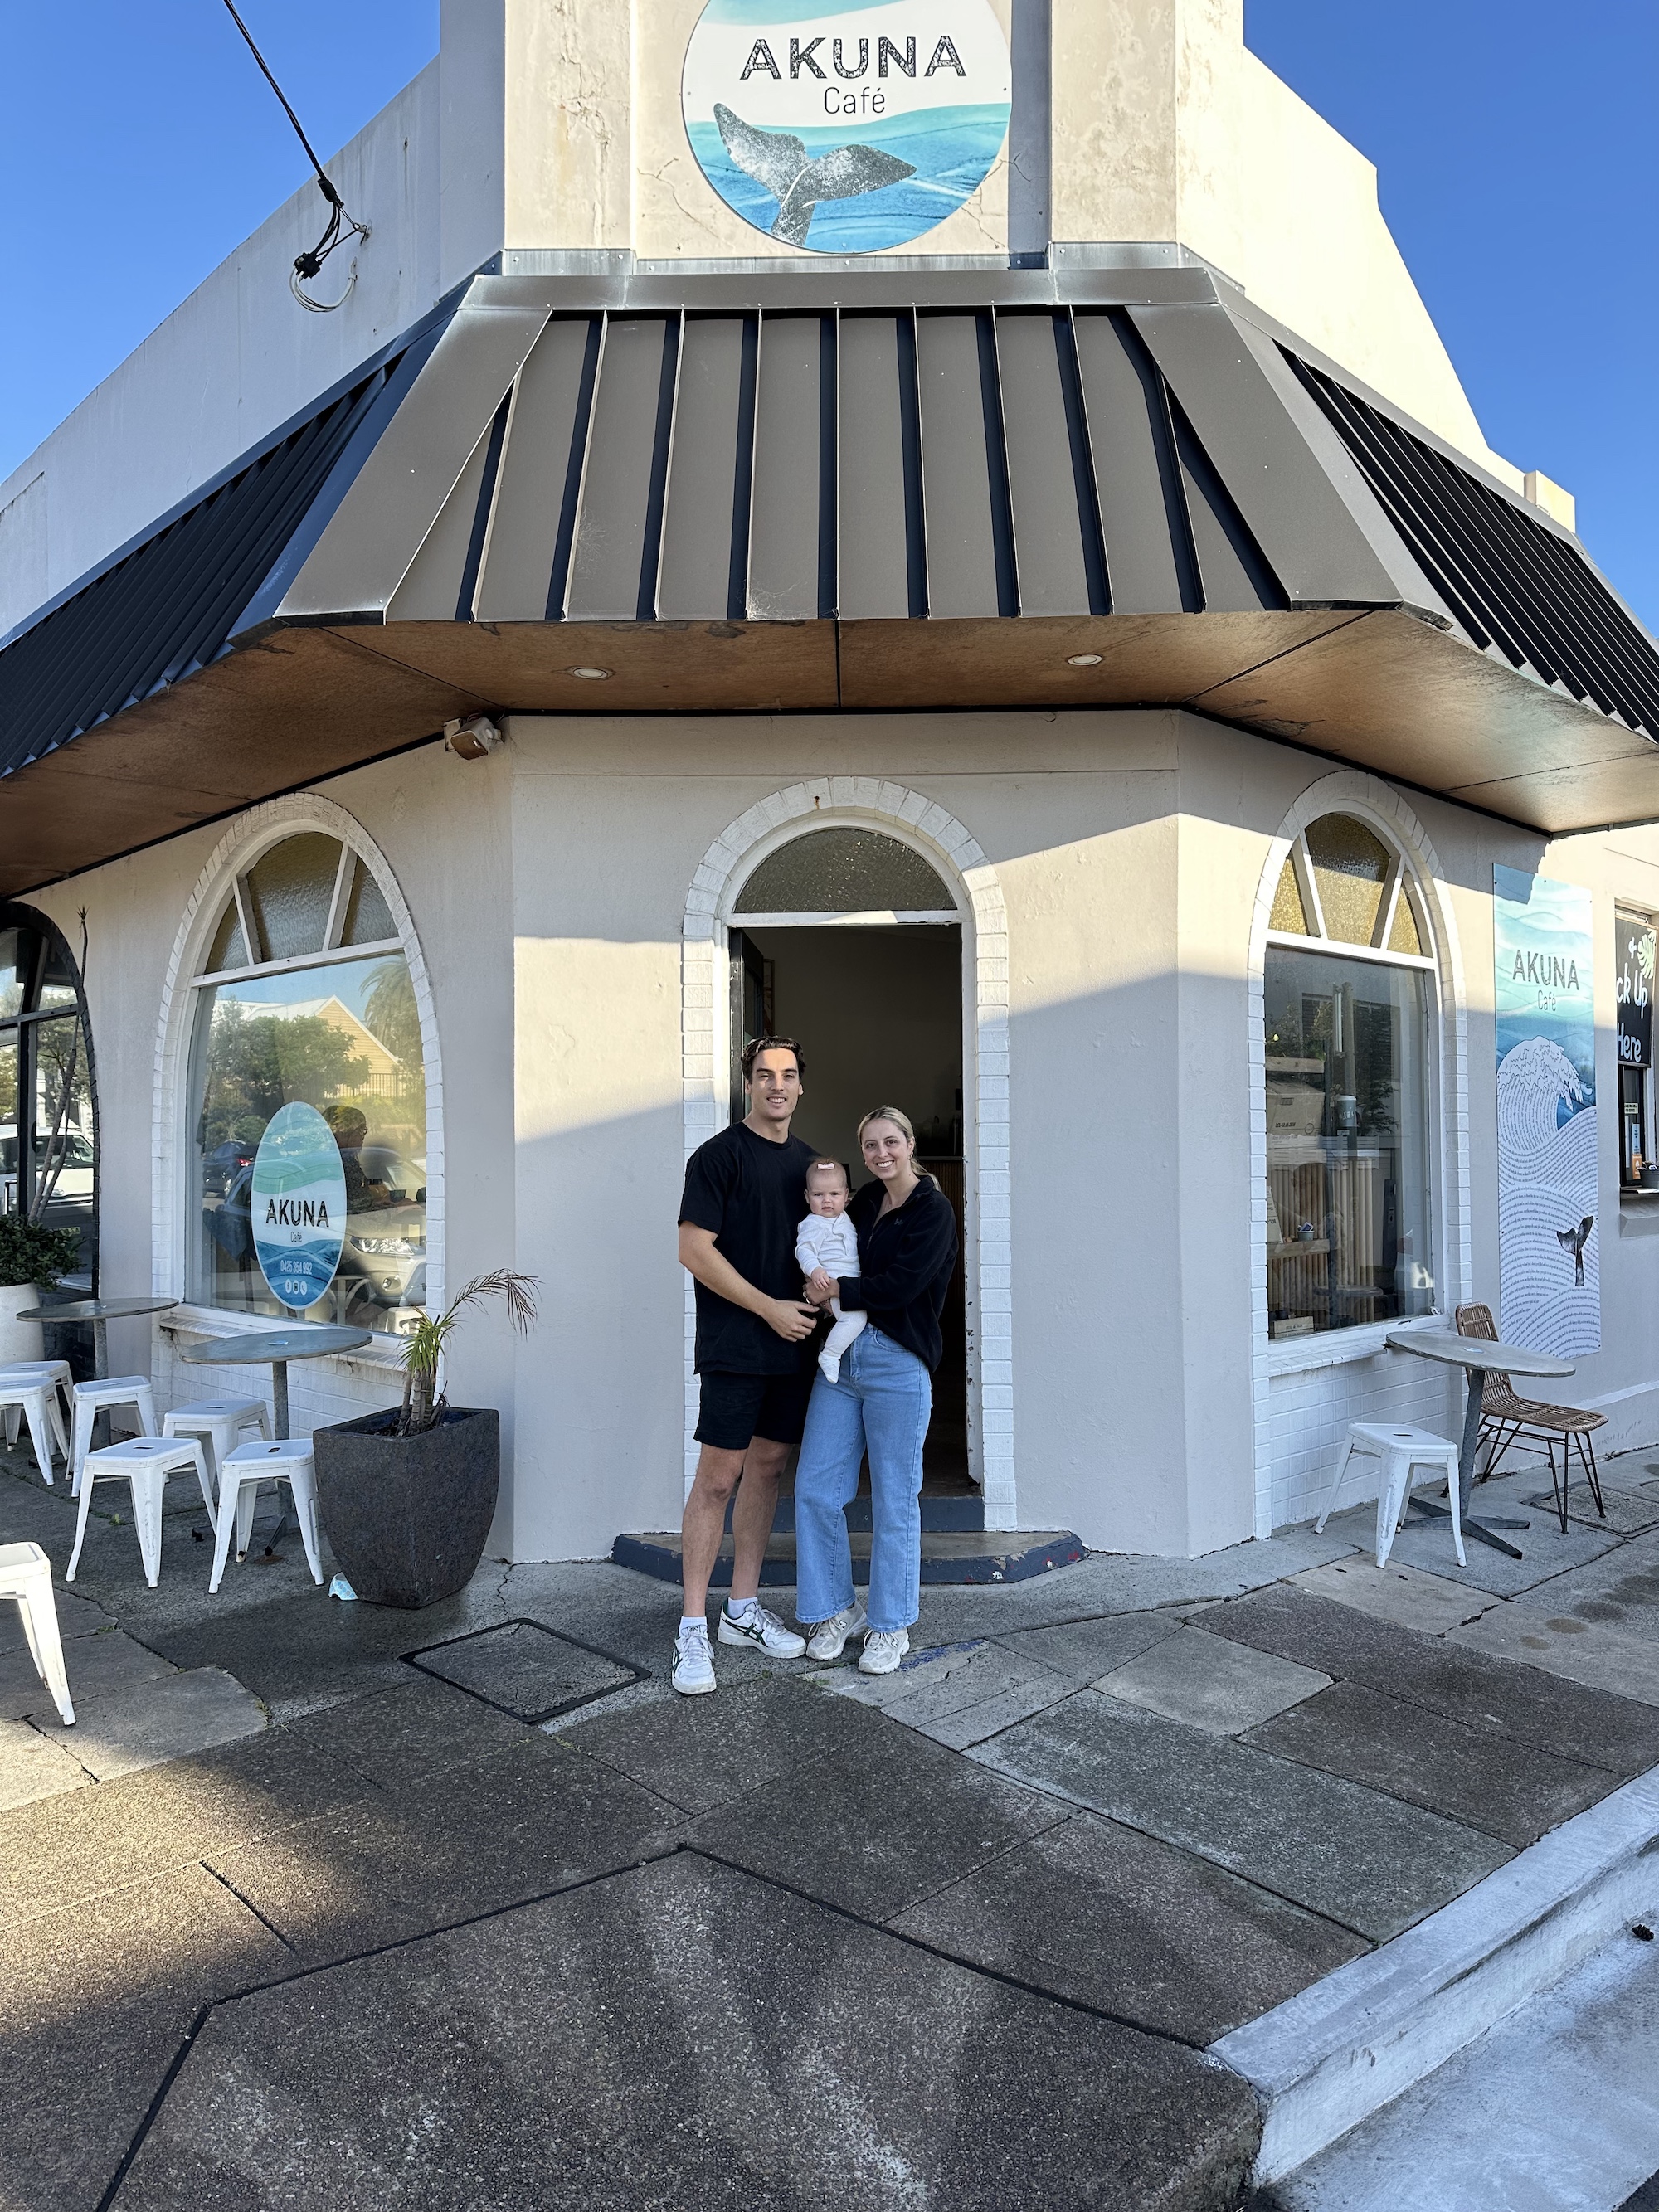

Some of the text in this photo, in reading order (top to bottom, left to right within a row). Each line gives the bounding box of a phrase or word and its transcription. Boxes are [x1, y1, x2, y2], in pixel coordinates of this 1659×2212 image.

[739, 36, 967, 80] AKUNA
[824, 86, 886, 114] Café
[1512, 949, 1580, 991] AKUNA
[1537, 989, 1557, 1012] Café
[1633, 969, 1648, 1020] Up
[1617, 1021, 1642, 1063] Here
[265, 1198, 329, 1228] AKUNA
